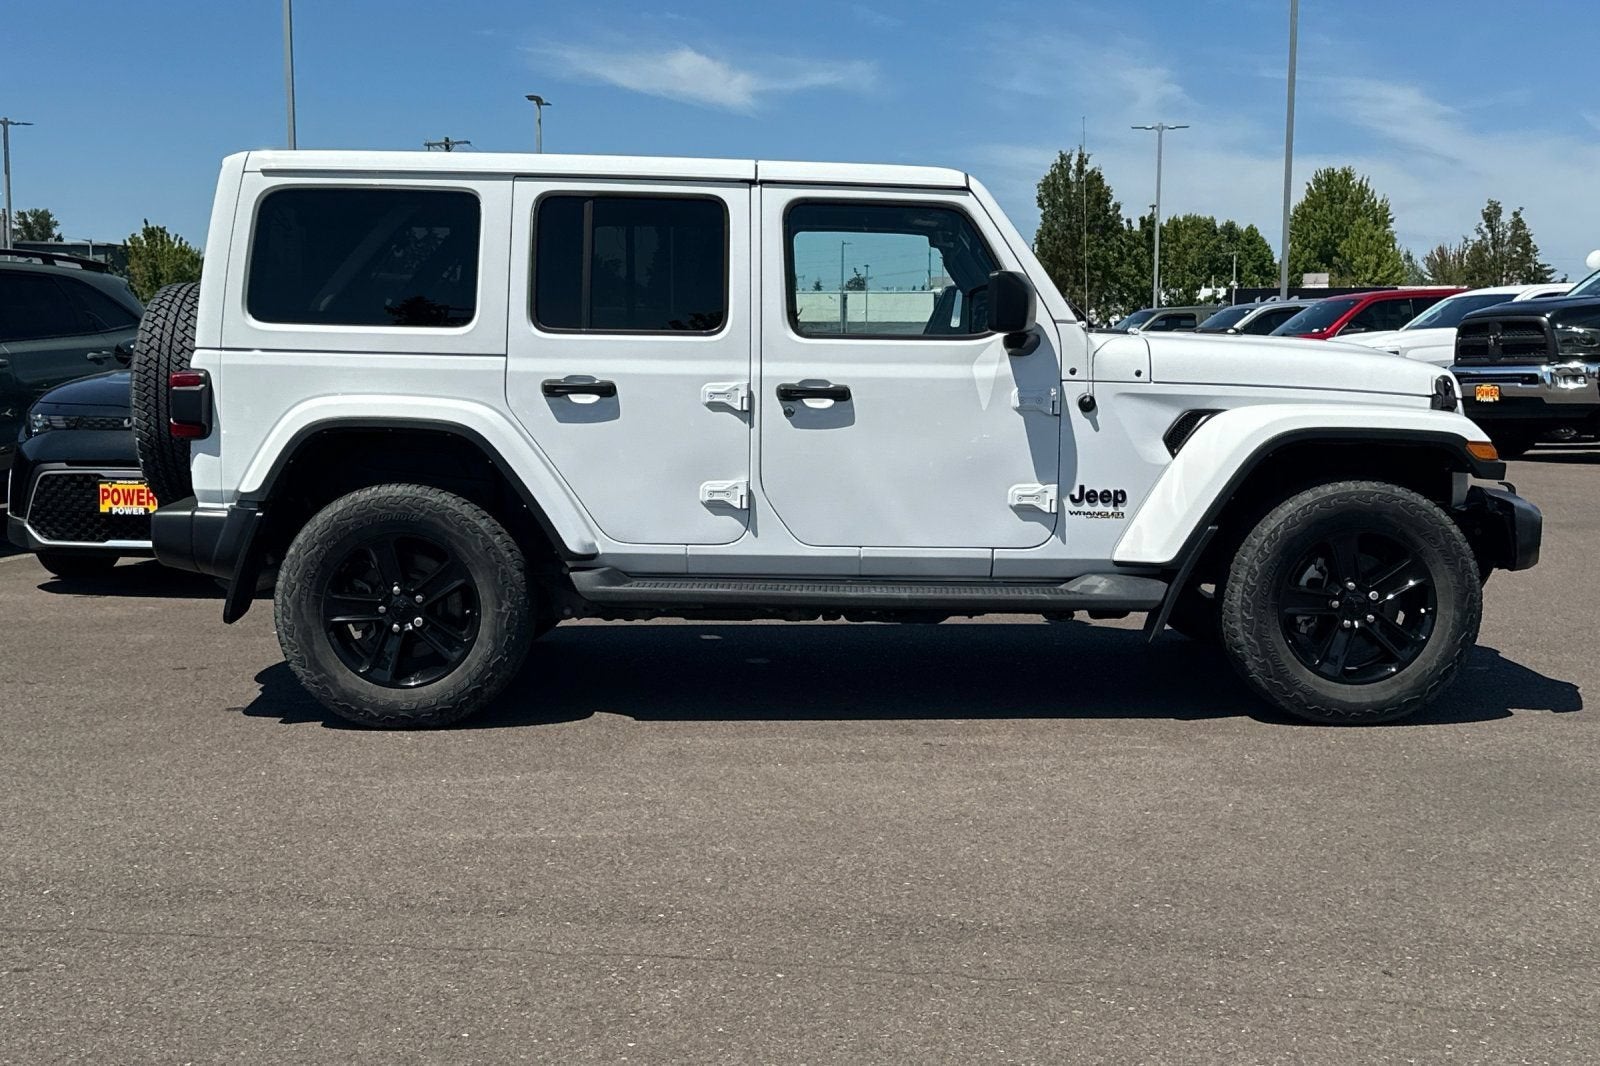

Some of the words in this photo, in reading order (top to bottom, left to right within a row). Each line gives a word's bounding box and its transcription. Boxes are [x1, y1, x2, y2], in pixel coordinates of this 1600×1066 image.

[1476, 388, 1498, 397] POWER
[101, 487, 157, 506] POWER
[1069, 484, 1127, 507] Jeep
[112, 507, 145, 515] POWER
